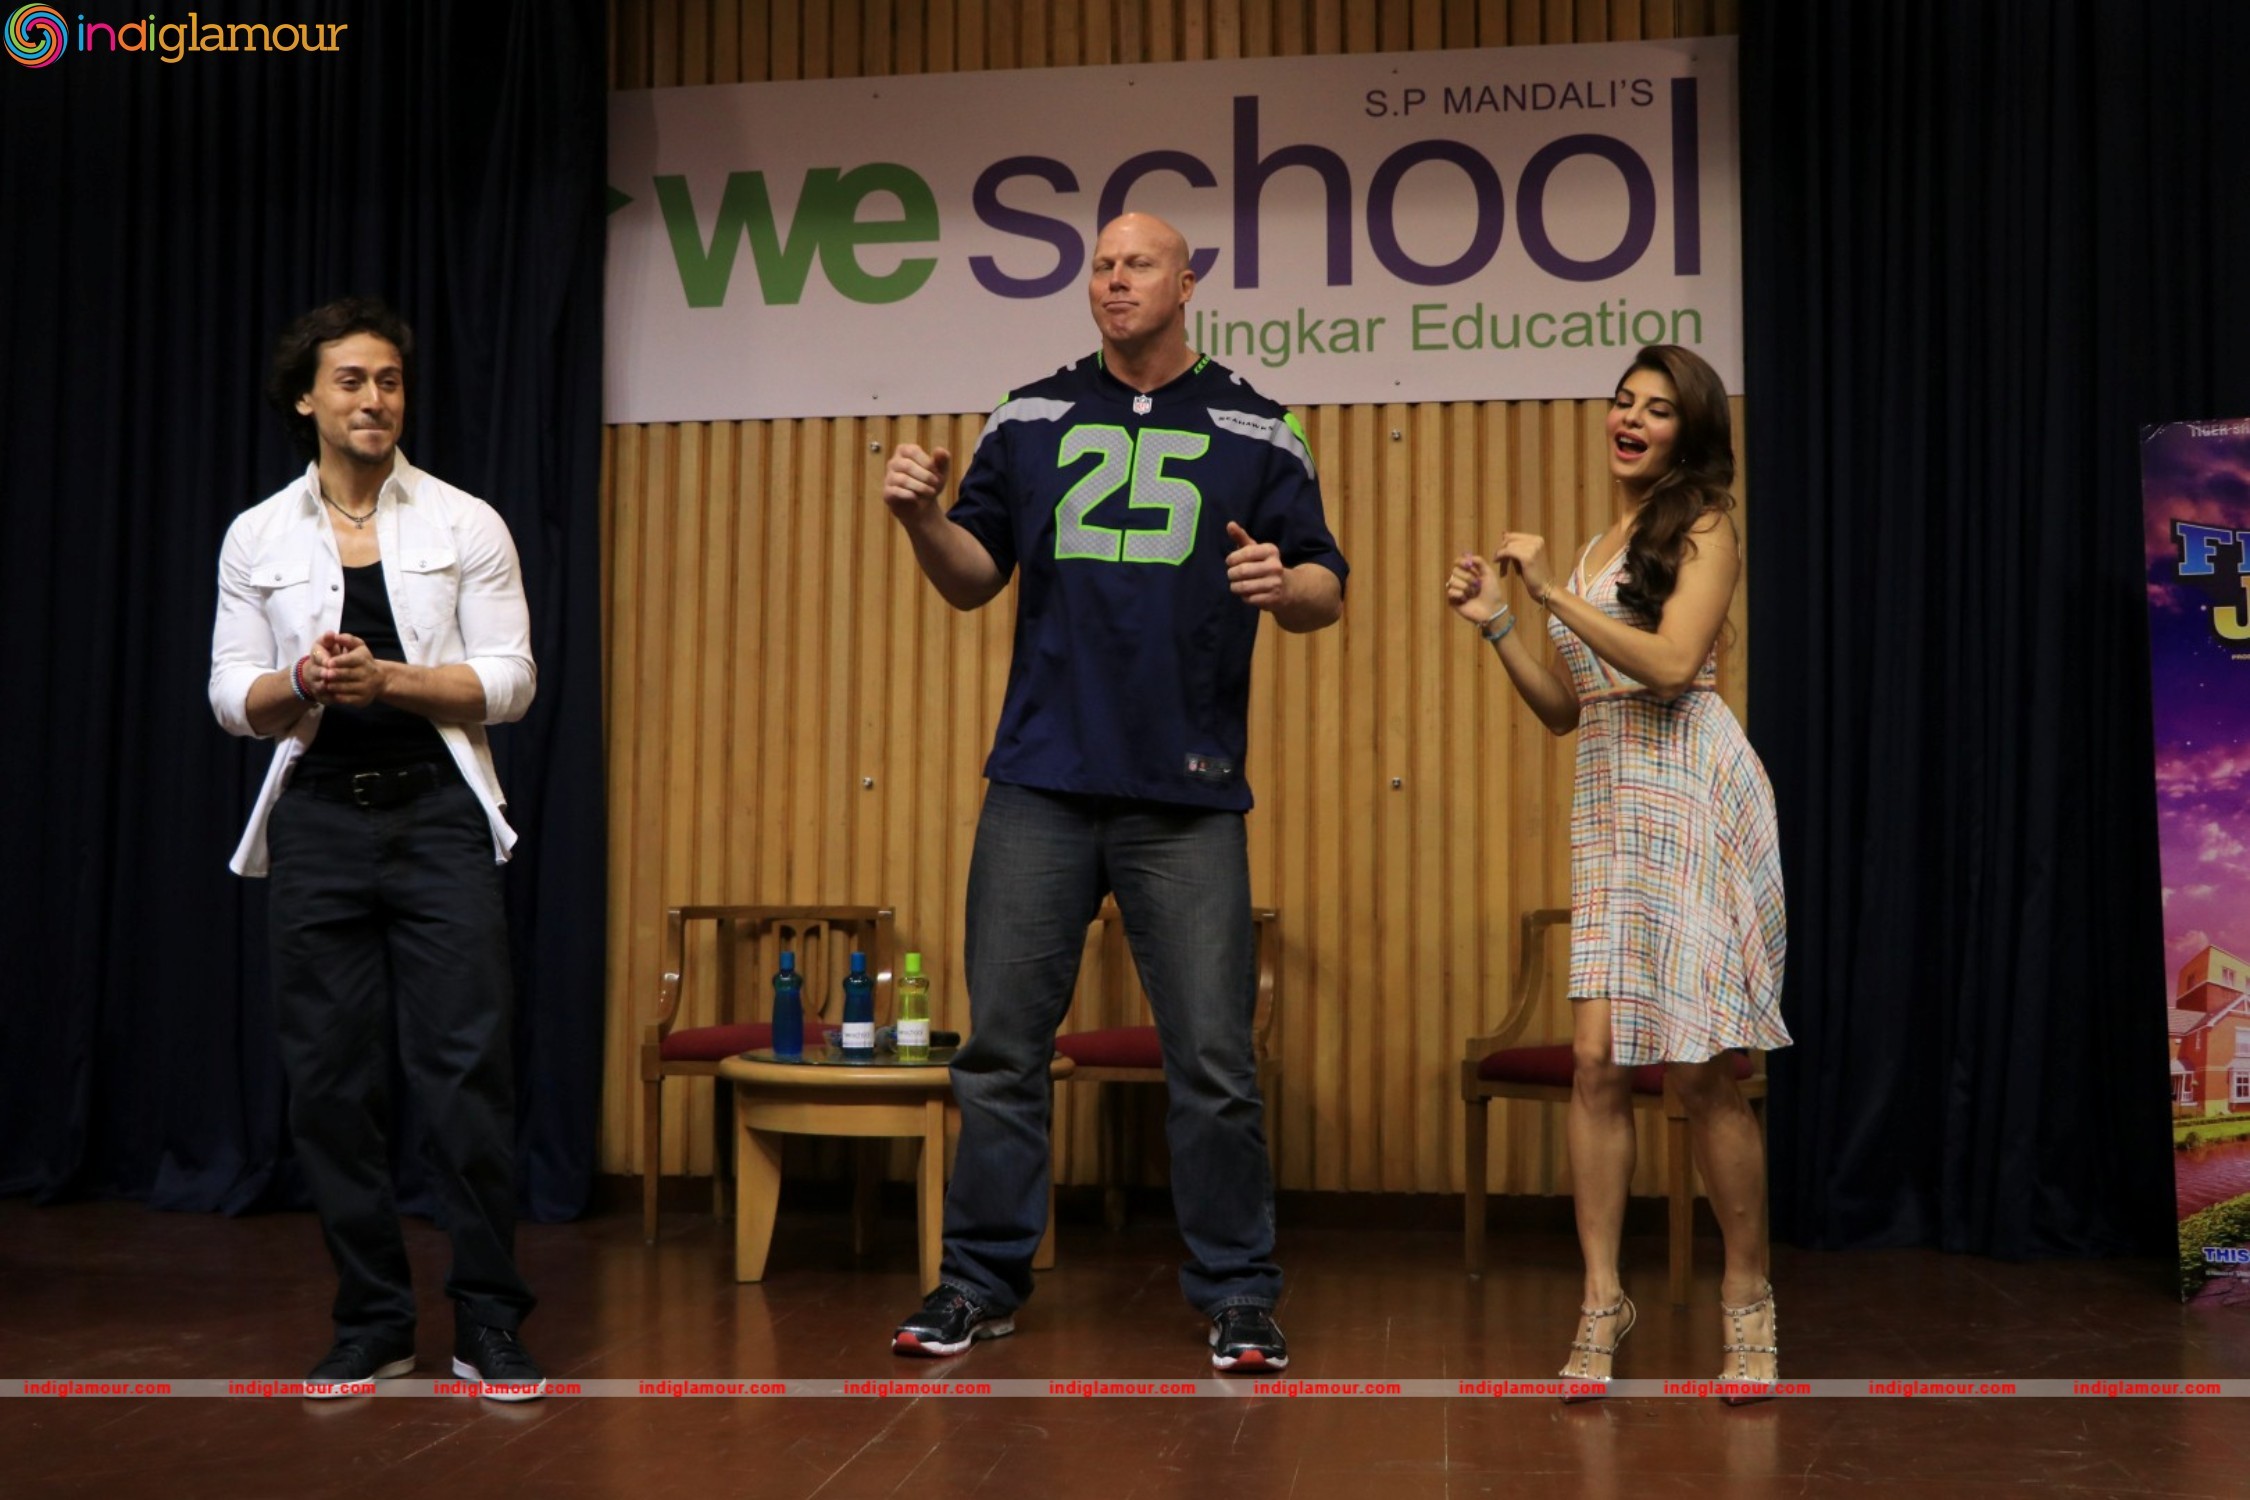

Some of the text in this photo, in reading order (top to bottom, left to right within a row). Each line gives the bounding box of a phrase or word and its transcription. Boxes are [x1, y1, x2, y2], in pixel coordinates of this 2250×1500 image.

[1365, 78, 1655, 118] S.P MANDALI'S
[652, 161, 940, 308] we
[1183, 297, 1703, 368] lingkar Education
[1054, 423, 1211, 567] 25
[2202, 1246, 2250, 1264] THIS
